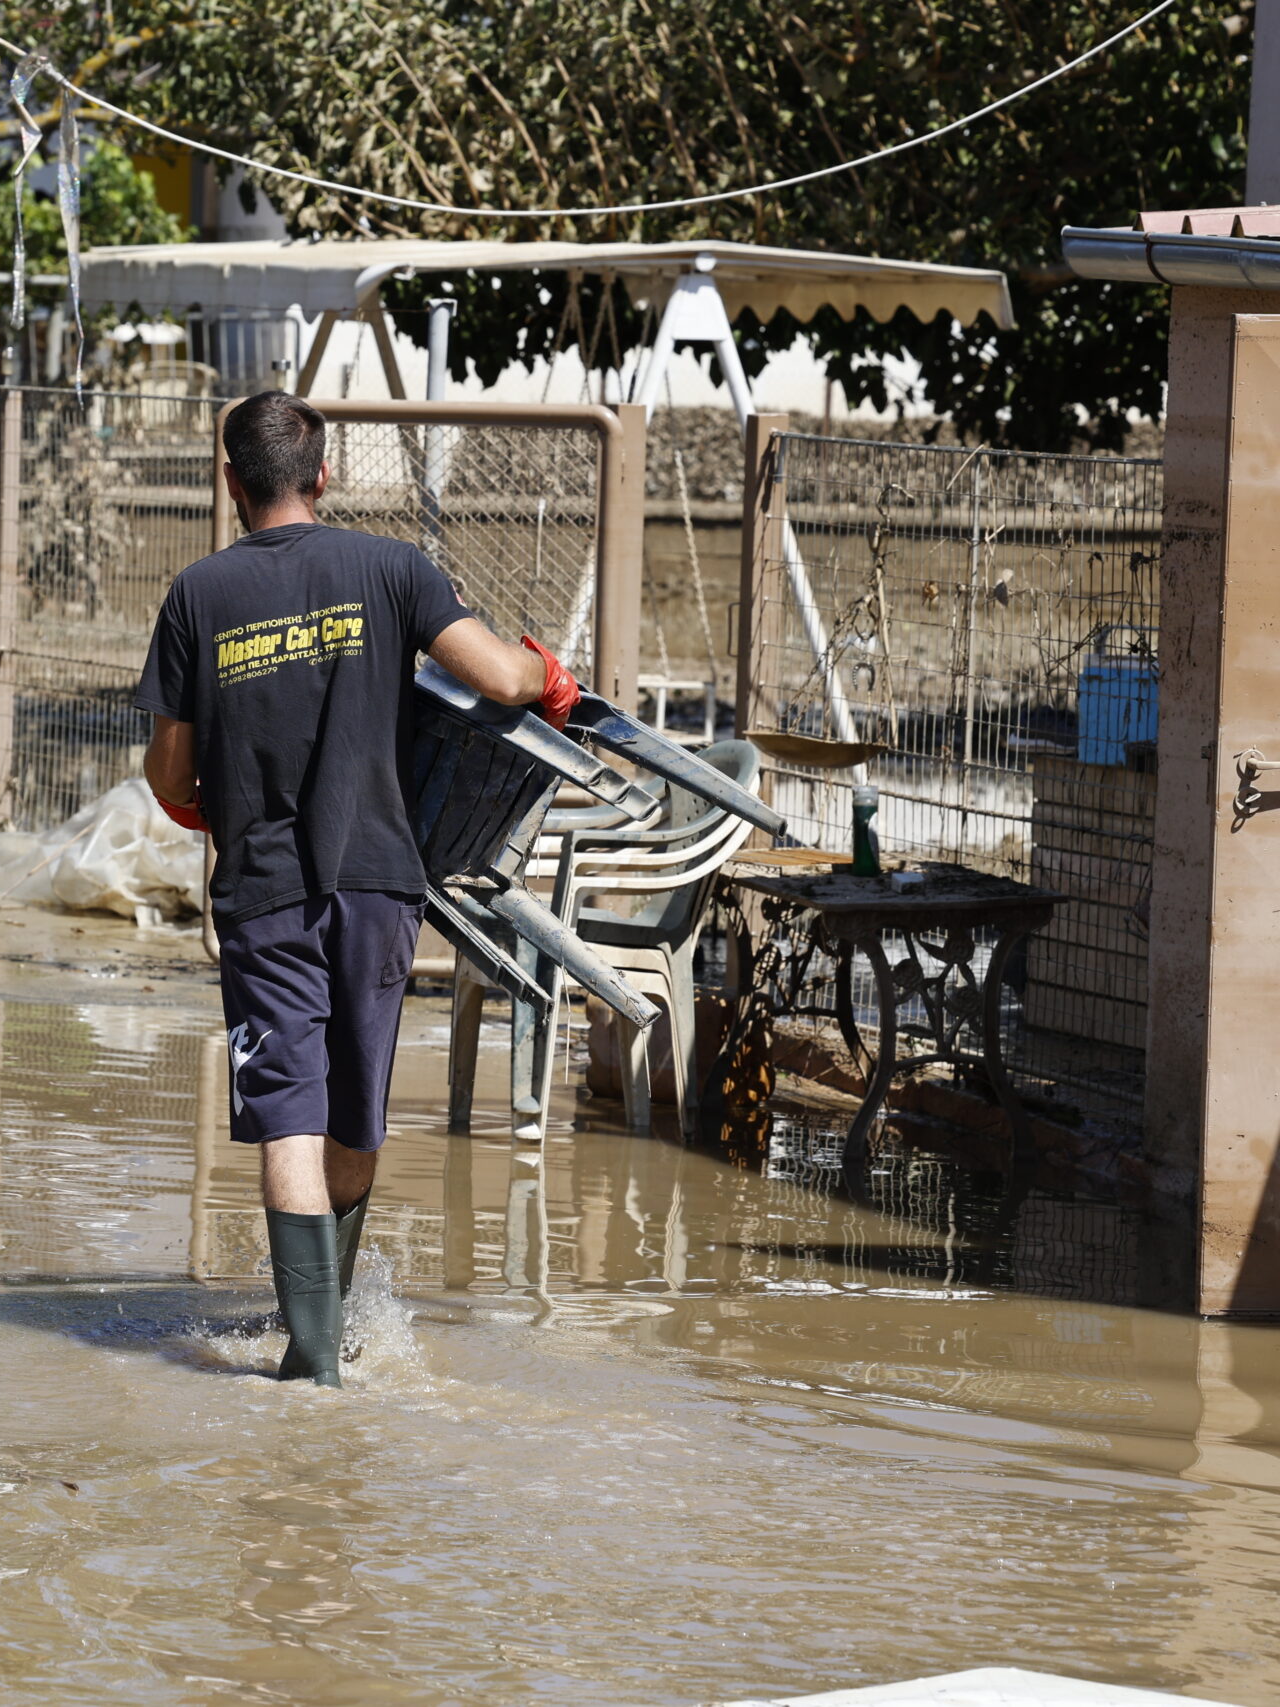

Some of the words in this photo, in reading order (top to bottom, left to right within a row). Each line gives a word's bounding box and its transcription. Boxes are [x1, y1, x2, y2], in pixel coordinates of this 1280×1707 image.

[214, 626, 244, 643] ΚΕΝΤΡΟ
[245, 615, 303, 633] ΠΕΡΙΠΟΙΗΣΗΣ
[305, 602, 364, 622] ΑΥΤΟΚΙΝΗΤΟΥ
[217, 632, 282, 669] Master
[285, 625, 318, 651] Car
[321, 617, 363, 643] Care
[271, 645, 319, 664] ΚΑΡΔΙΤΣΑΣ
[325, 639, 364, 653] ΤΡΙΚΑΛΩΝ
